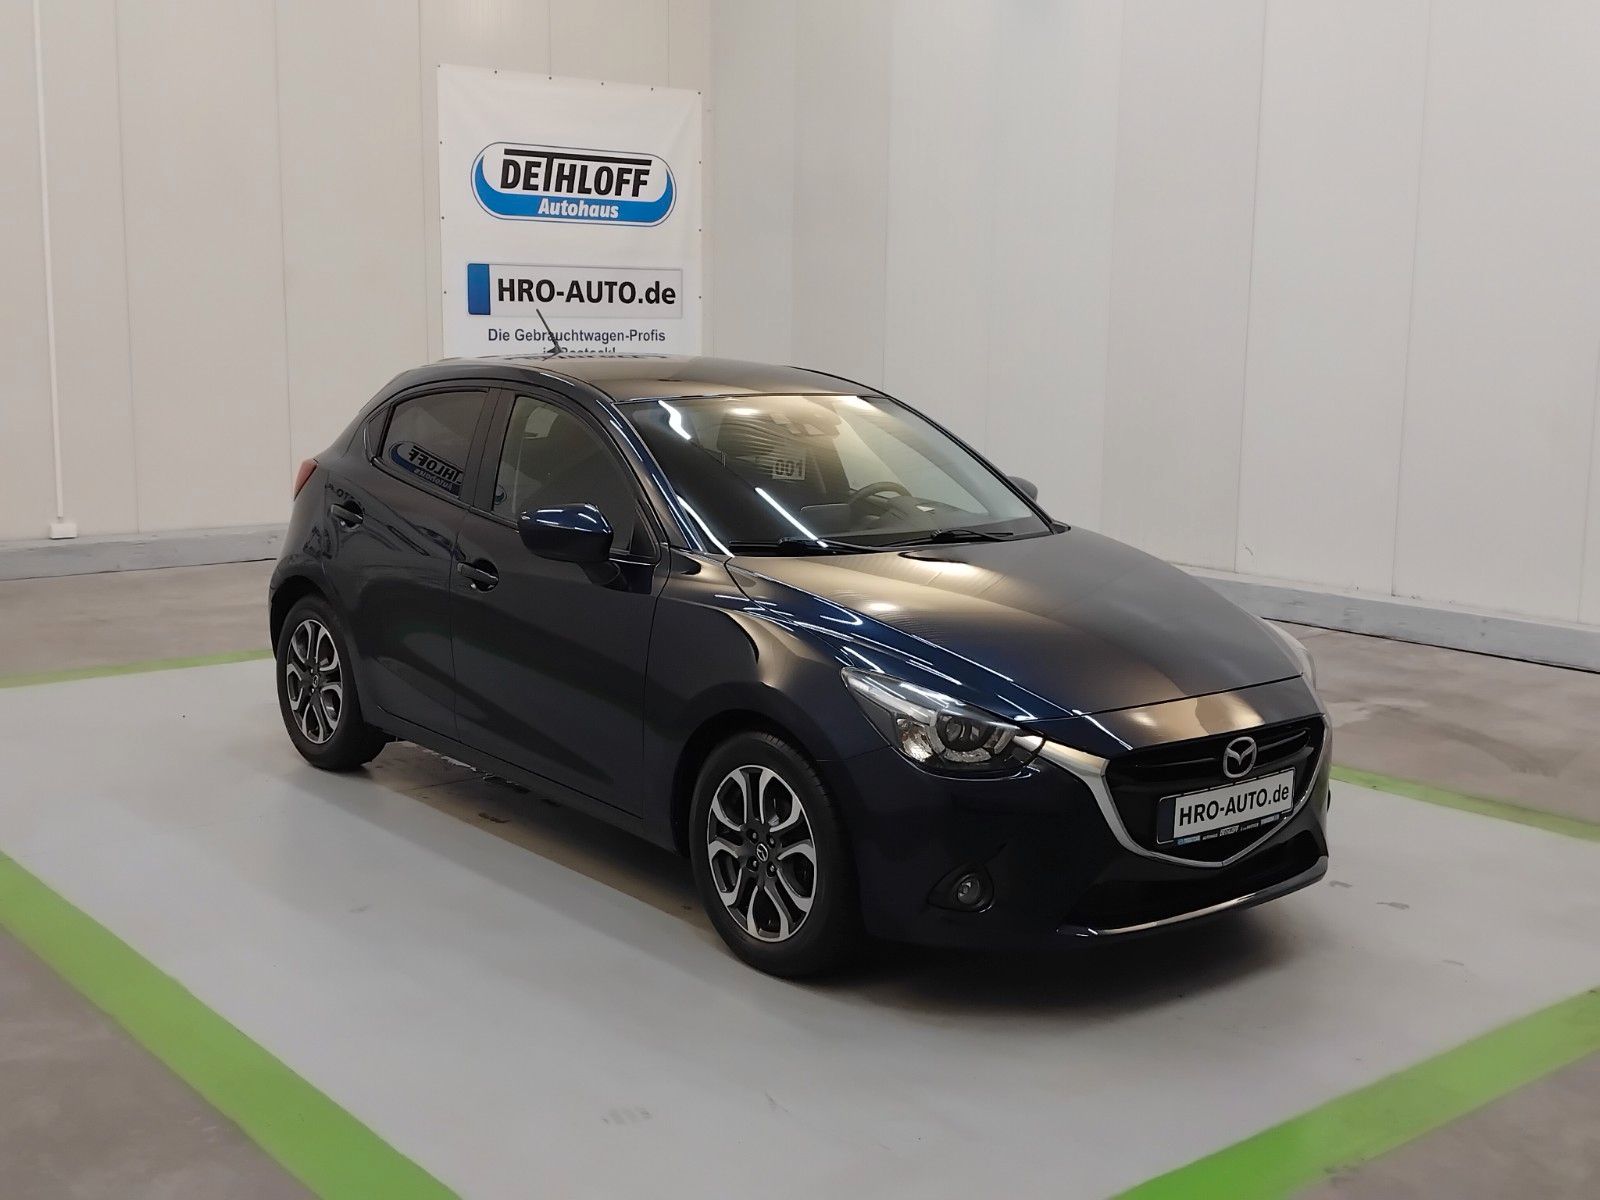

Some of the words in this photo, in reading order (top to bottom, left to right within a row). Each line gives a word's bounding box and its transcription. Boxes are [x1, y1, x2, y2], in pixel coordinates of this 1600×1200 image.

[500, 148, 652, 198] DETHLOFF
[537, 197, 620, 219] Autohaus
[497, 278, 677, 305] HRO-AUTO.de
[488, 328, 510, 342] Die
[514, 328, 666, 345] Gebrauchtwagen-Profis
[1178, 783, 1290, 827] HRO-AUTO.de
